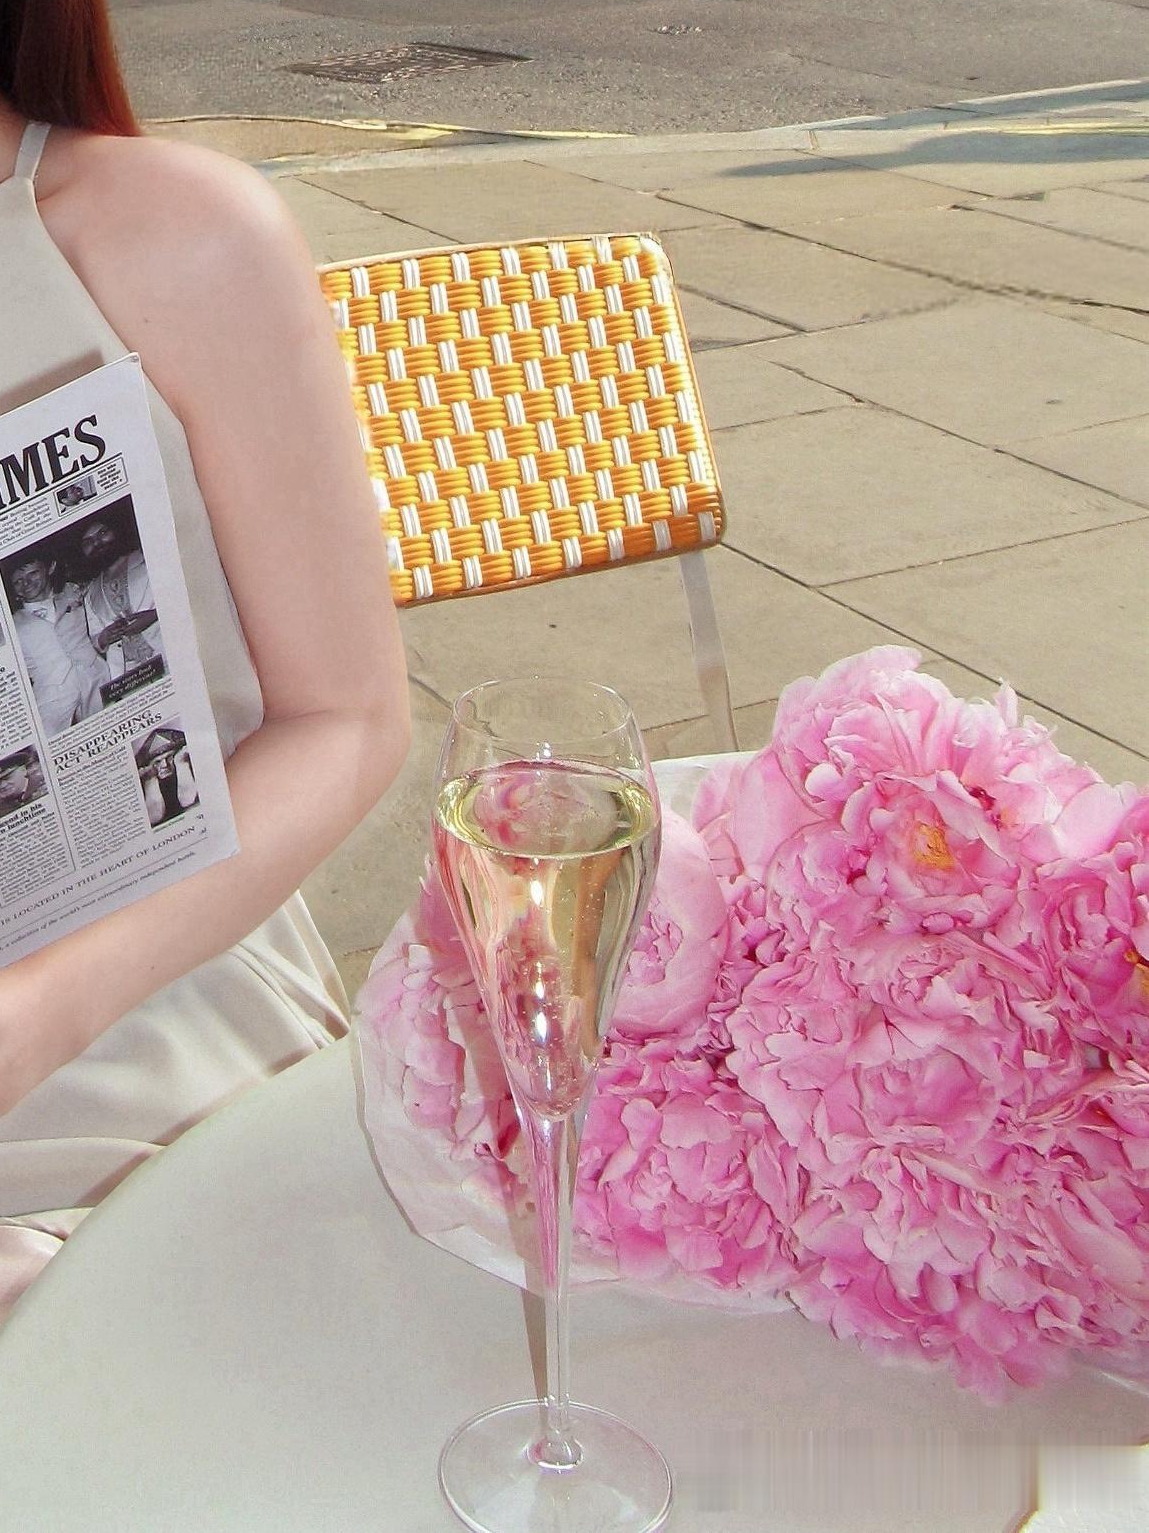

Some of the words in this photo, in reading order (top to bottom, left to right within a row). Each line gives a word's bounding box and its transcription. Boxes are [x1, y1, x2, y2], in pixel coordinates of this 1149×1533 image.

[53, 710, 152, 766] DISAPPEARING
[56, 756, 82, 774] ACT
[88, 712, 162, 757] REAPPEARS
[13, 893, 60, 920] LOCATED
[60, 884, 74, 895] IN
[74, 872, 97, 888] THE
[99, 856, 133, 877] HEART
[135, 847, 151, 858] OF
[151, 825, 197, 851] LONDON
